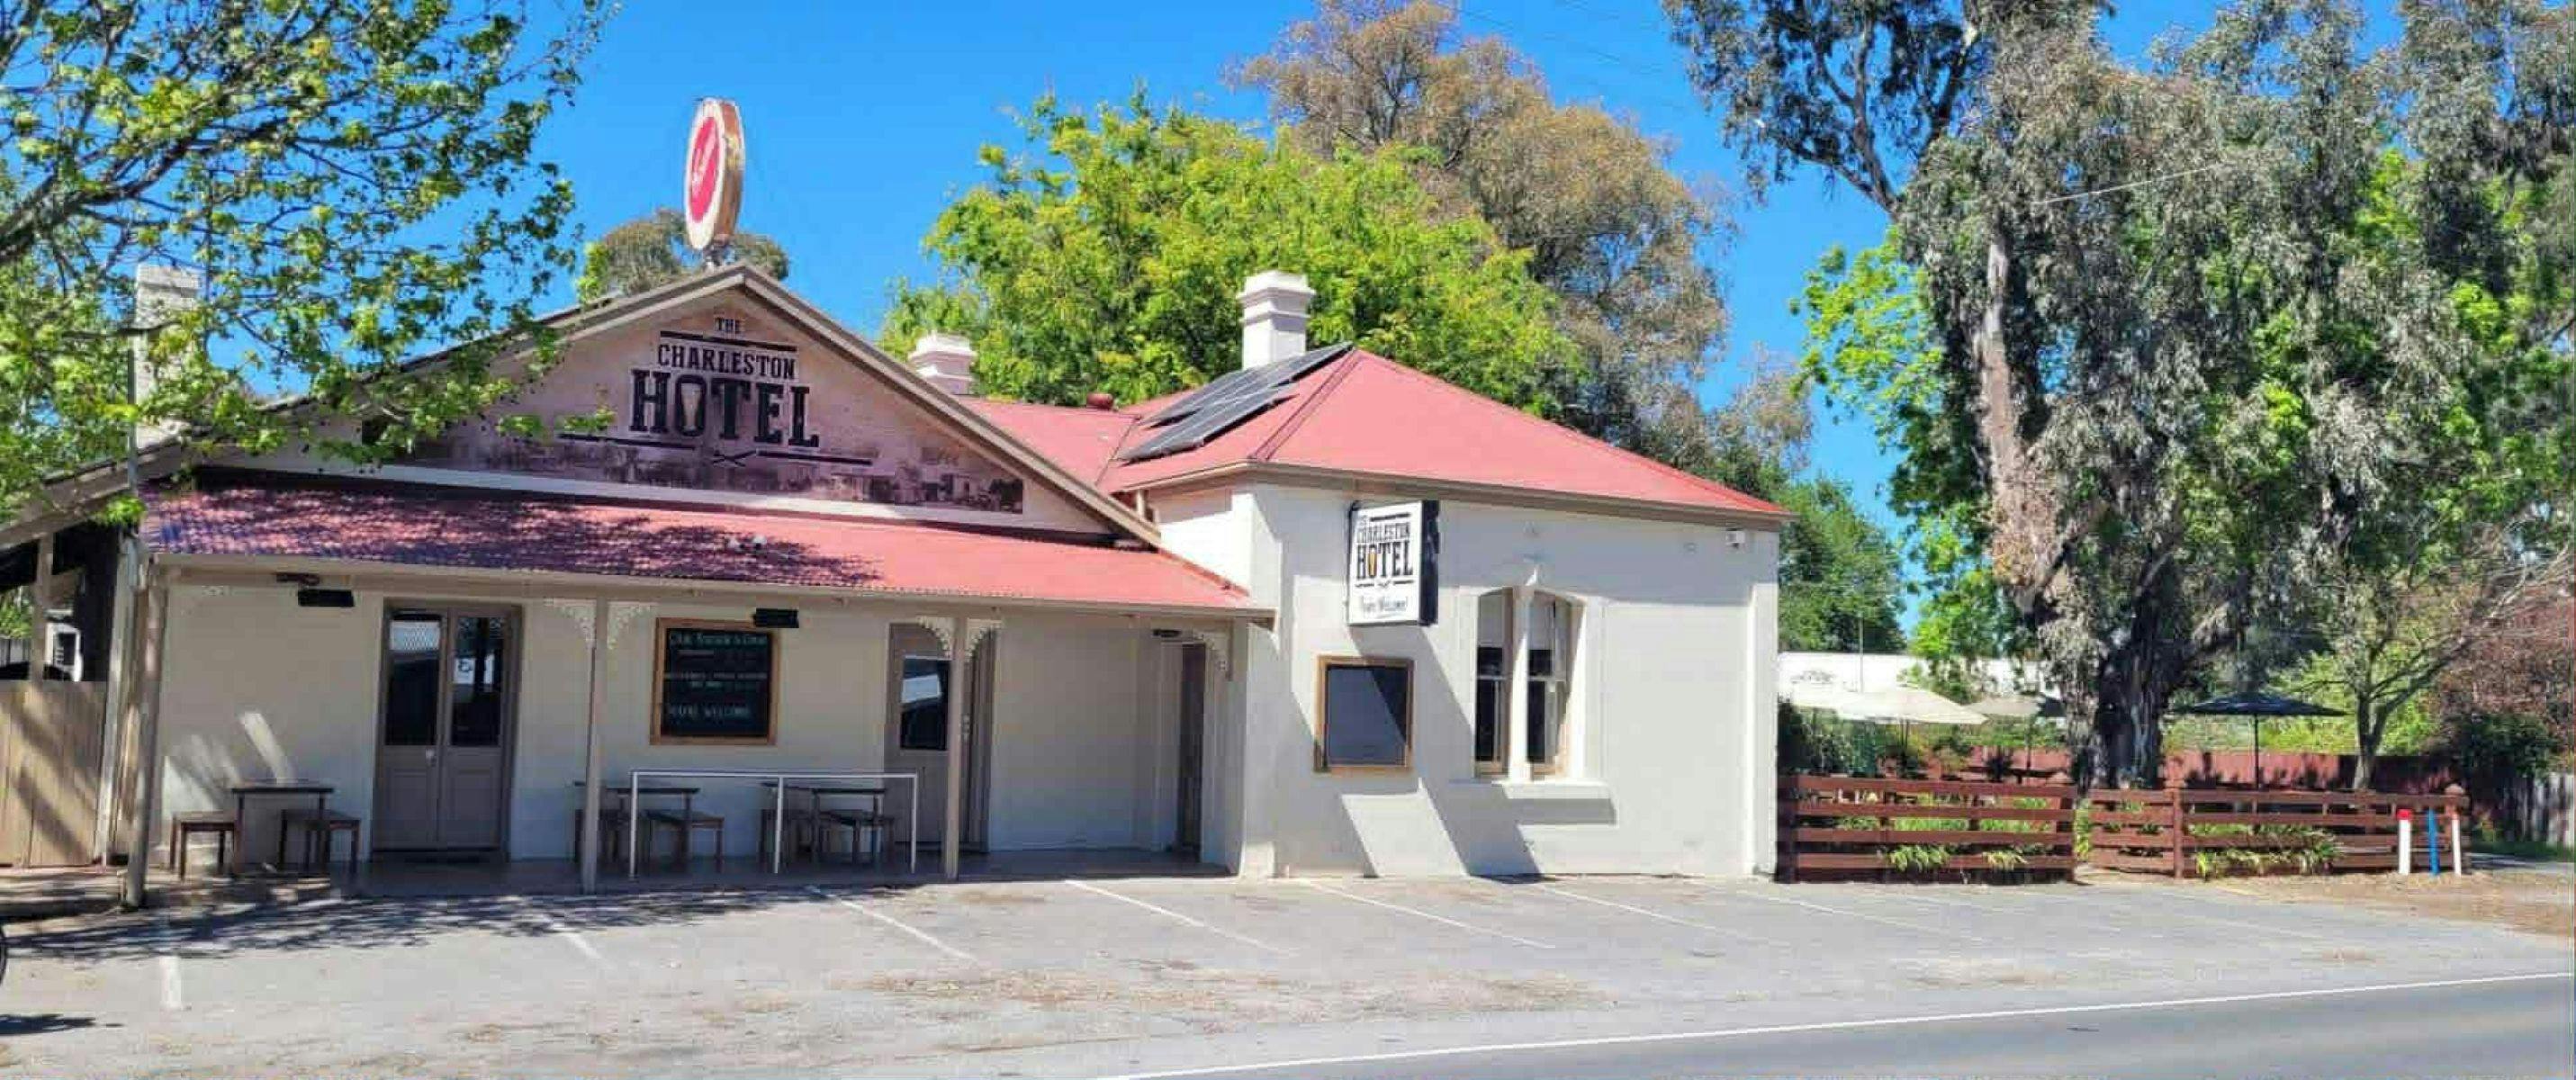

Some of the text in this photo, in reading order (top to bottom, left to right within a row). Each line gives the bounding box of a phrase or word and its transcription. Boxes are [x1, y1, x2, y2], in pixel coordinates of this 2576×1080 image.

[717, 318, 742, 334] THE
[658, 343, 796, 380] CHARLESTON
[630, 369, 820, 448] HOTEL
[1356, 541, 1414, 580] HOTEL
